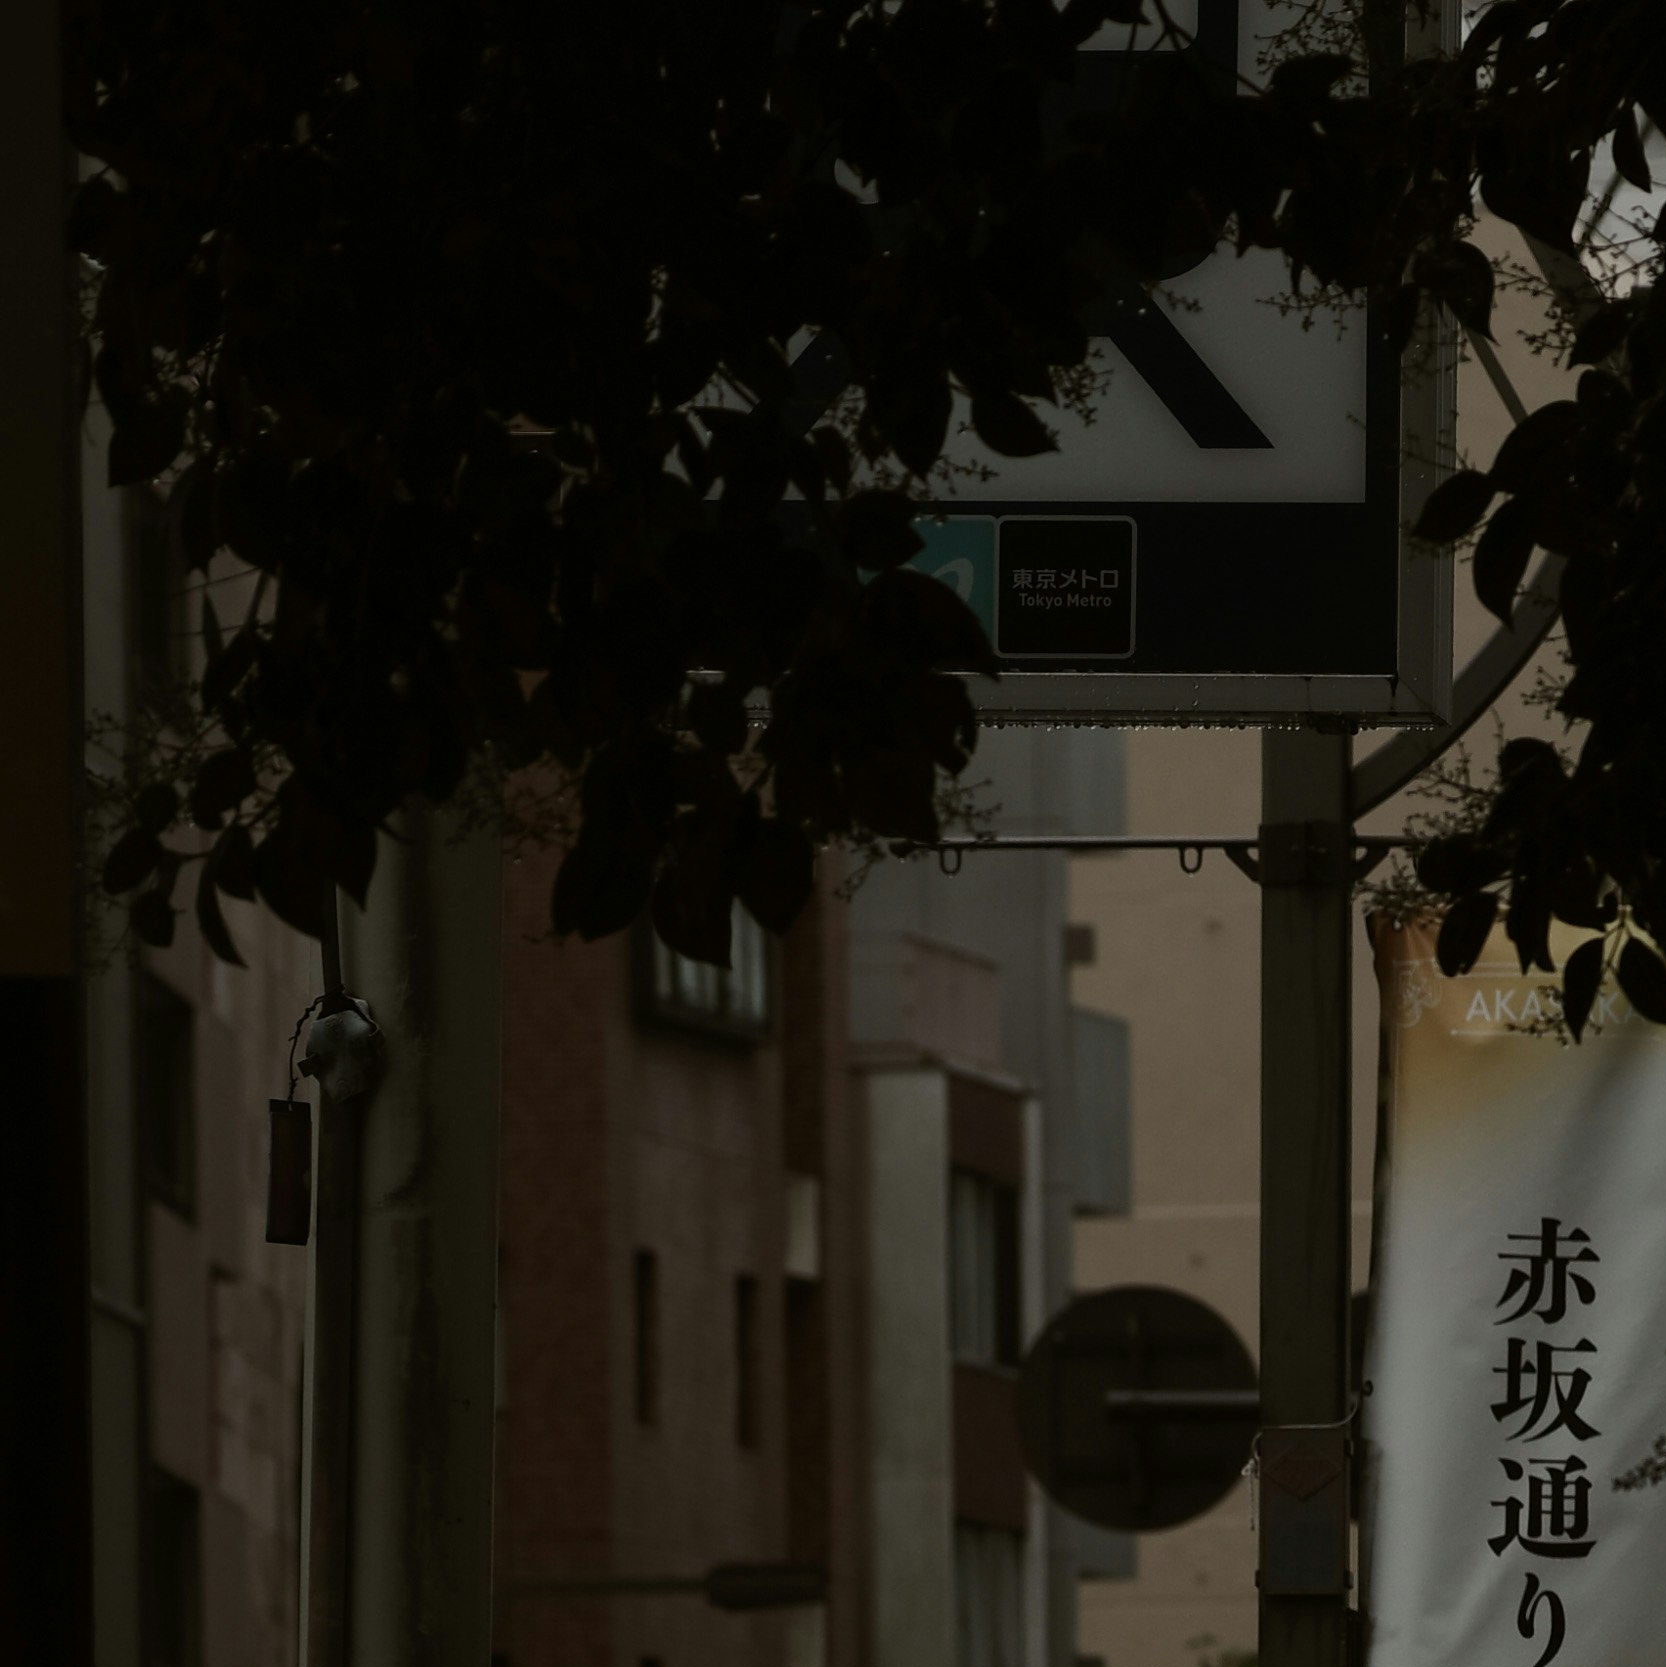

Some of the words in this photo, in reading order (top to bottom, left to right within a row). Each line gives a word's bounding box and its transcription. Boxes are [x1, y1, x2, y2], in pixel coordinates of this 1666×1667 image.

[1011, 568, 1120, 590] 東京メトロ
[1018, 592, 1063, 610] Tokyo
[1066, 592, 1113, 608] Metro
